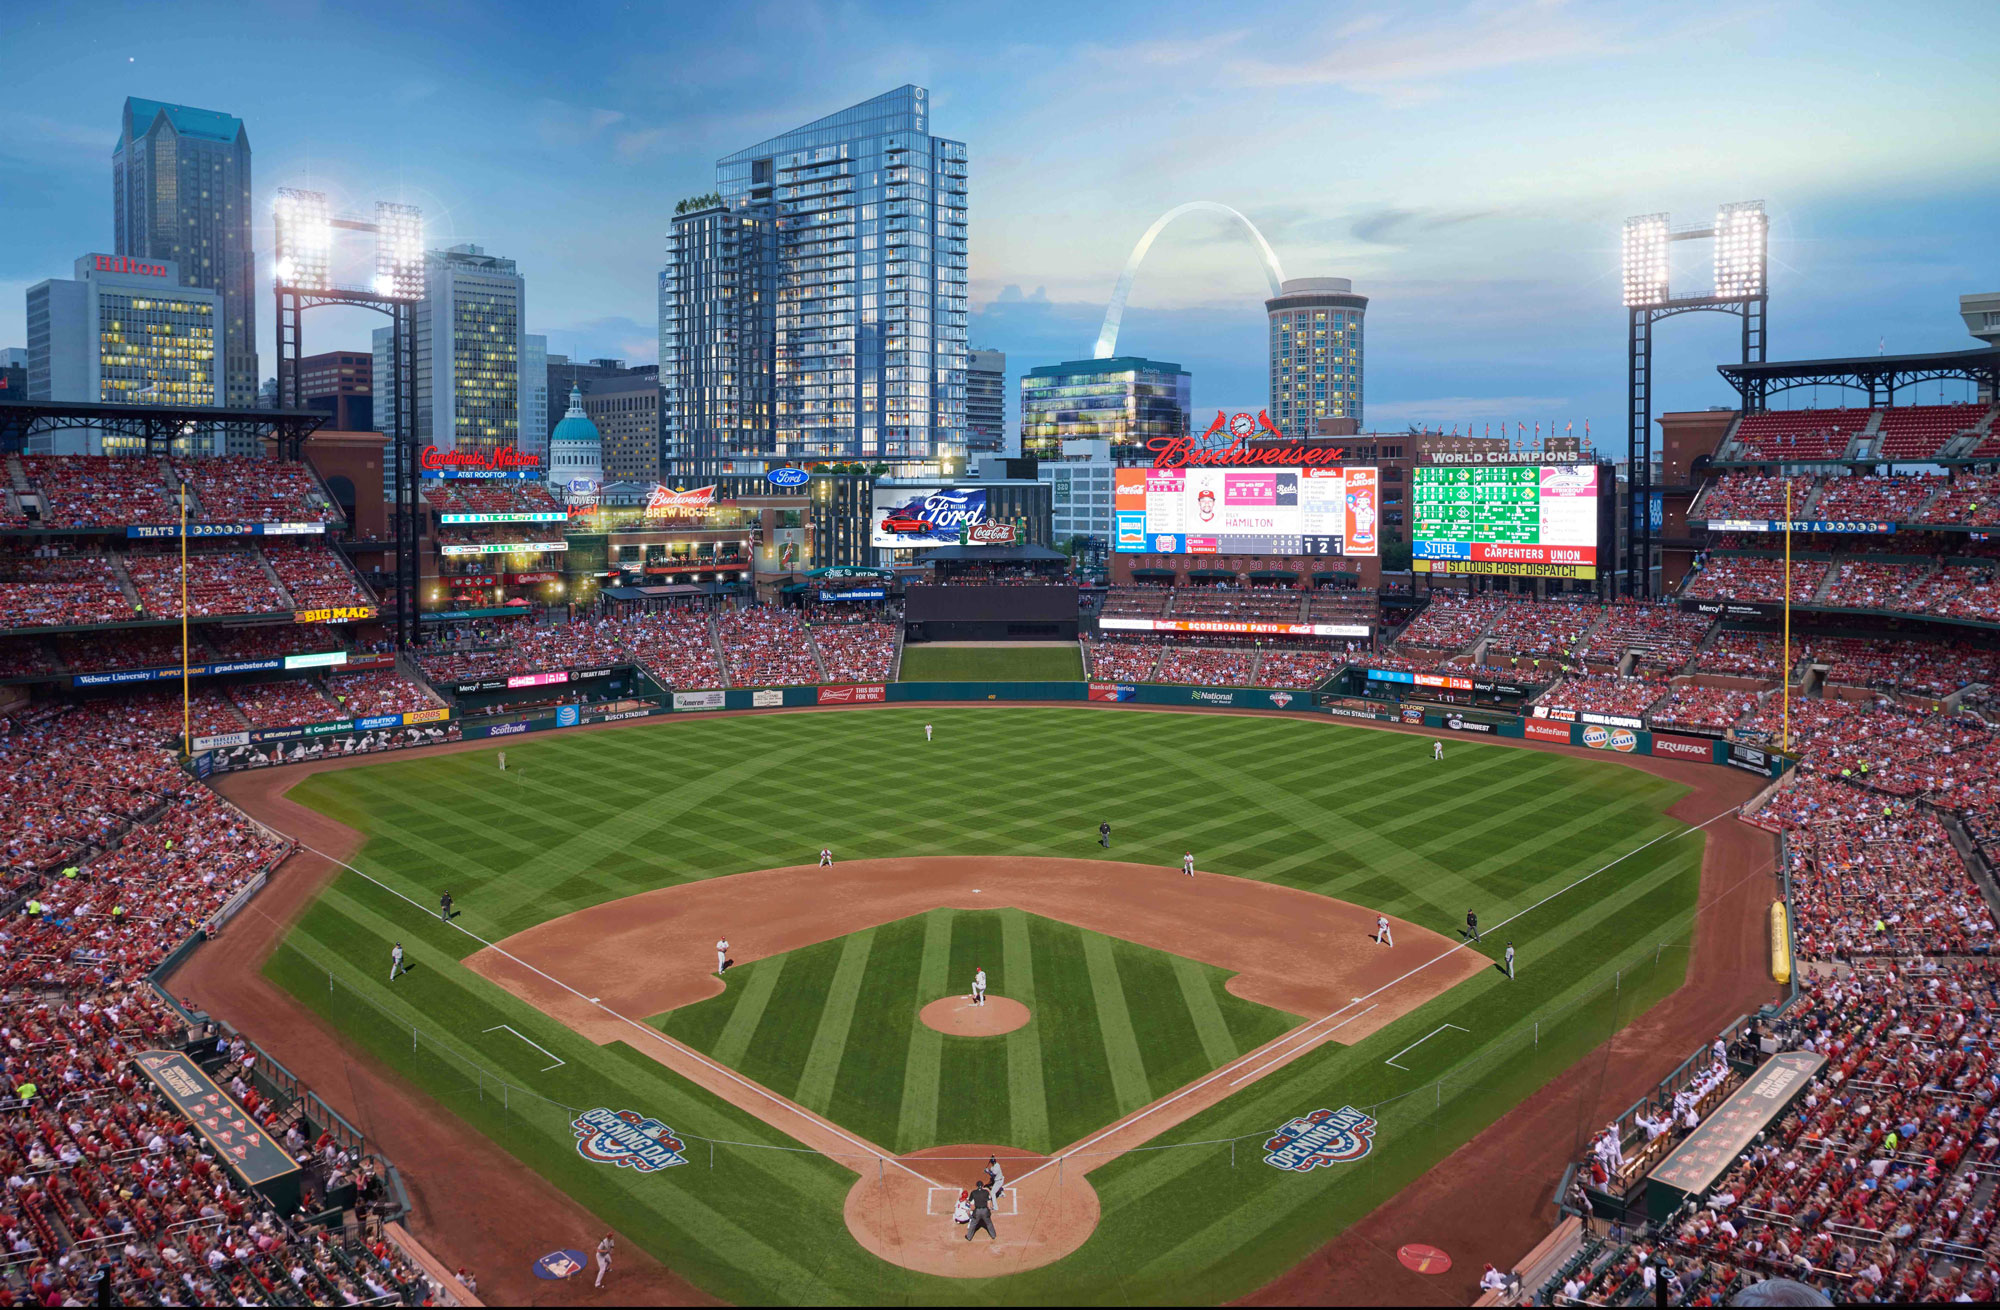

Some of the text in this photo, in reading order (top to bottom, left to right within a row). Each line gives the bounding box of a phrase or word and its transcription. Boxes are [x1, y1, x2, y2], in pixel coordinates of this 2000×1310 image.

[915, 87, 924, 131] ONE
[95, 255, 167, 277] Hilton
[421, 445, 539, 470] Cardinals Nation
[1146, 436, 1344, 468] Budweiser
[1431, 452, 1578, 464] WORLD CHAMPIONS
[776, 471, 802, 484] Ford
[1346, 478, 1375, 487] CARDS!
[572, 480, 592, 492] FOX
[1276, 484, 1298, 495] Reds
[564, 496, 600, 505] MIDWEST
[646, 492, 714, 508] Budweiser
[567, 504, 598, 518] Live!
[646, 506, 716, 518] BREW HOUSE
[918, 496, 984, 526] Ford
[1226, 518, 1274, 528] HAMILTON
[1774, 522, 1808, 531] THAT'S
[1812, 522, 1820, 531] A
[1826, 522, 1877, 532] POWER
[138, 526, 174, 537] THAT'S
[193, 526, 242, 534] POWER
[974, 526, 1009, 540] Coca-Cola
[1305, 542, 1340, 554] 1 2 1
[1425, 541, 1458, 554] STIFEL
[1484, 548, 1581, 560] CARPENTERS UNION
[1145, 560, 1346, 571] 1 2 6 9 10 14 17 20 24 42 45 85
[1432, 561, 1445, 570] stl
[1450, 561, 1577, 577] ST. LOUIS POST-DISPATCH
[304, 607, 369, 622] BIG MAC
[1699, 604, 1720, 613] Mercy
[1188, 622, 1247, 631] SCOREBOARD
[80, 674, 111, 683] Webster
[112, 671, 151, 682] University
[186, 667, 206, 675] ODAY
[214, 660, 278, 674] grad.webster.edu
[1475, 683, 1491, 691] Mercy
[1201, 692, 1233, 700] National
[413, 711, 441, 720] DOBBS
[605, 713, 623, 721] BUSCH
[625, 710, 649, 718] STADIUM
[1332, 709, 1351, 717] BUSCH
[1351, 710, 1376, 719] STADIUM
[1582, 713, 1604, 723] BROWN
[314, 722, 354, 734] Central Bank
[362, 717, 397, 727] ATHLETICO
[1463, 723, 1490, 732] MIDWEST
[491, 723, 526, 736] Scottrade
[1584, 732, 1634, 746] Gulf Gulf
[1656, 741, 1707, 754] EQUIFAX
[583, 1108, 683, 1168] OPENING DAY
[1270, 1106, 1365, 1169] OPENING DAY
